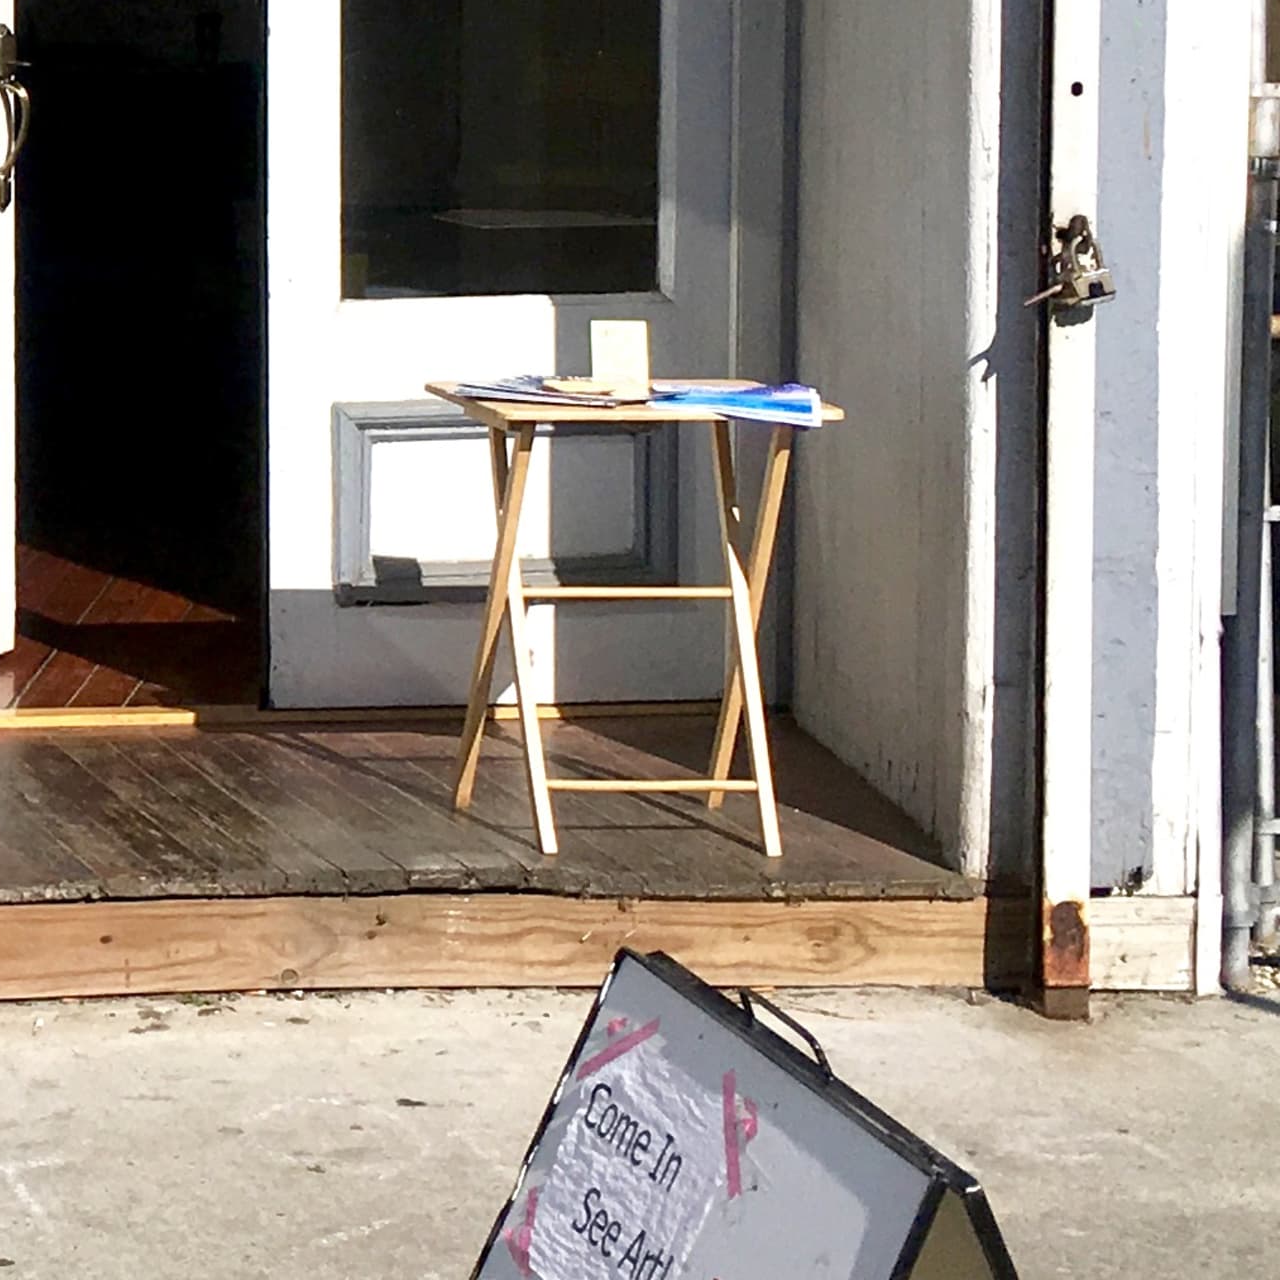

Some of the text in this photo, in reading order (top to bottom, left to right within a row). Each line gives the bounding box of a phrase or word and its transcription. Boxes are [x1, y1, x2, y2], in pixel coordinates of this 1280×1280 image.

[584, 1083, 683, 1192] Come In
[572, 1188, 622, 1257] See
